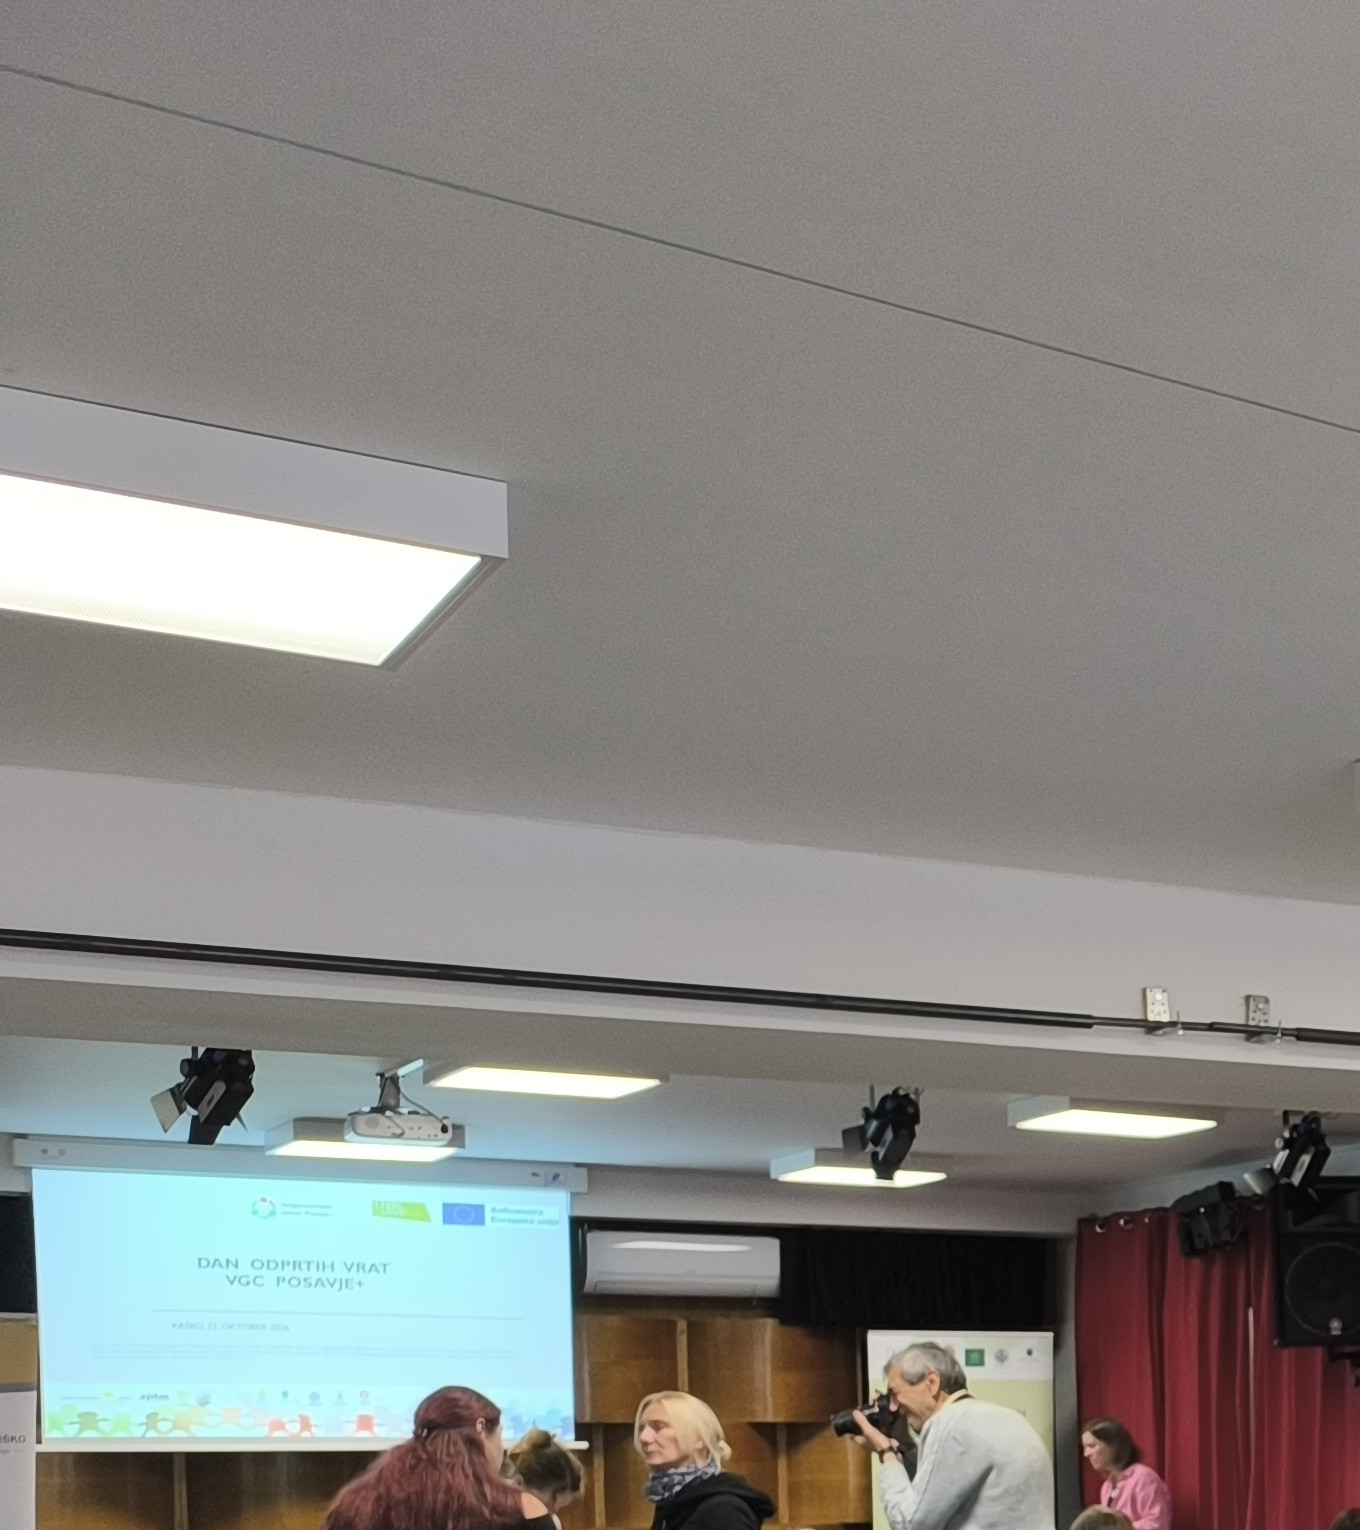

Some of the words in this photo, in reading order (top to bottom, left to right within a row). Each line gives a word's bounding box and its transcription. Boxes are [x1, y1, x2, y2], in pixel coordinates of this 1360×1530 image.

[197, 1257, 239, 1270] DAN
[250, 1258, 335, 1273] ODPRTIH
[343, 1261, 391, 1274] VRAT
[225, 1274, 265, 1287] VGC
[276, 1275, 365, 1292] POSAVJE+
